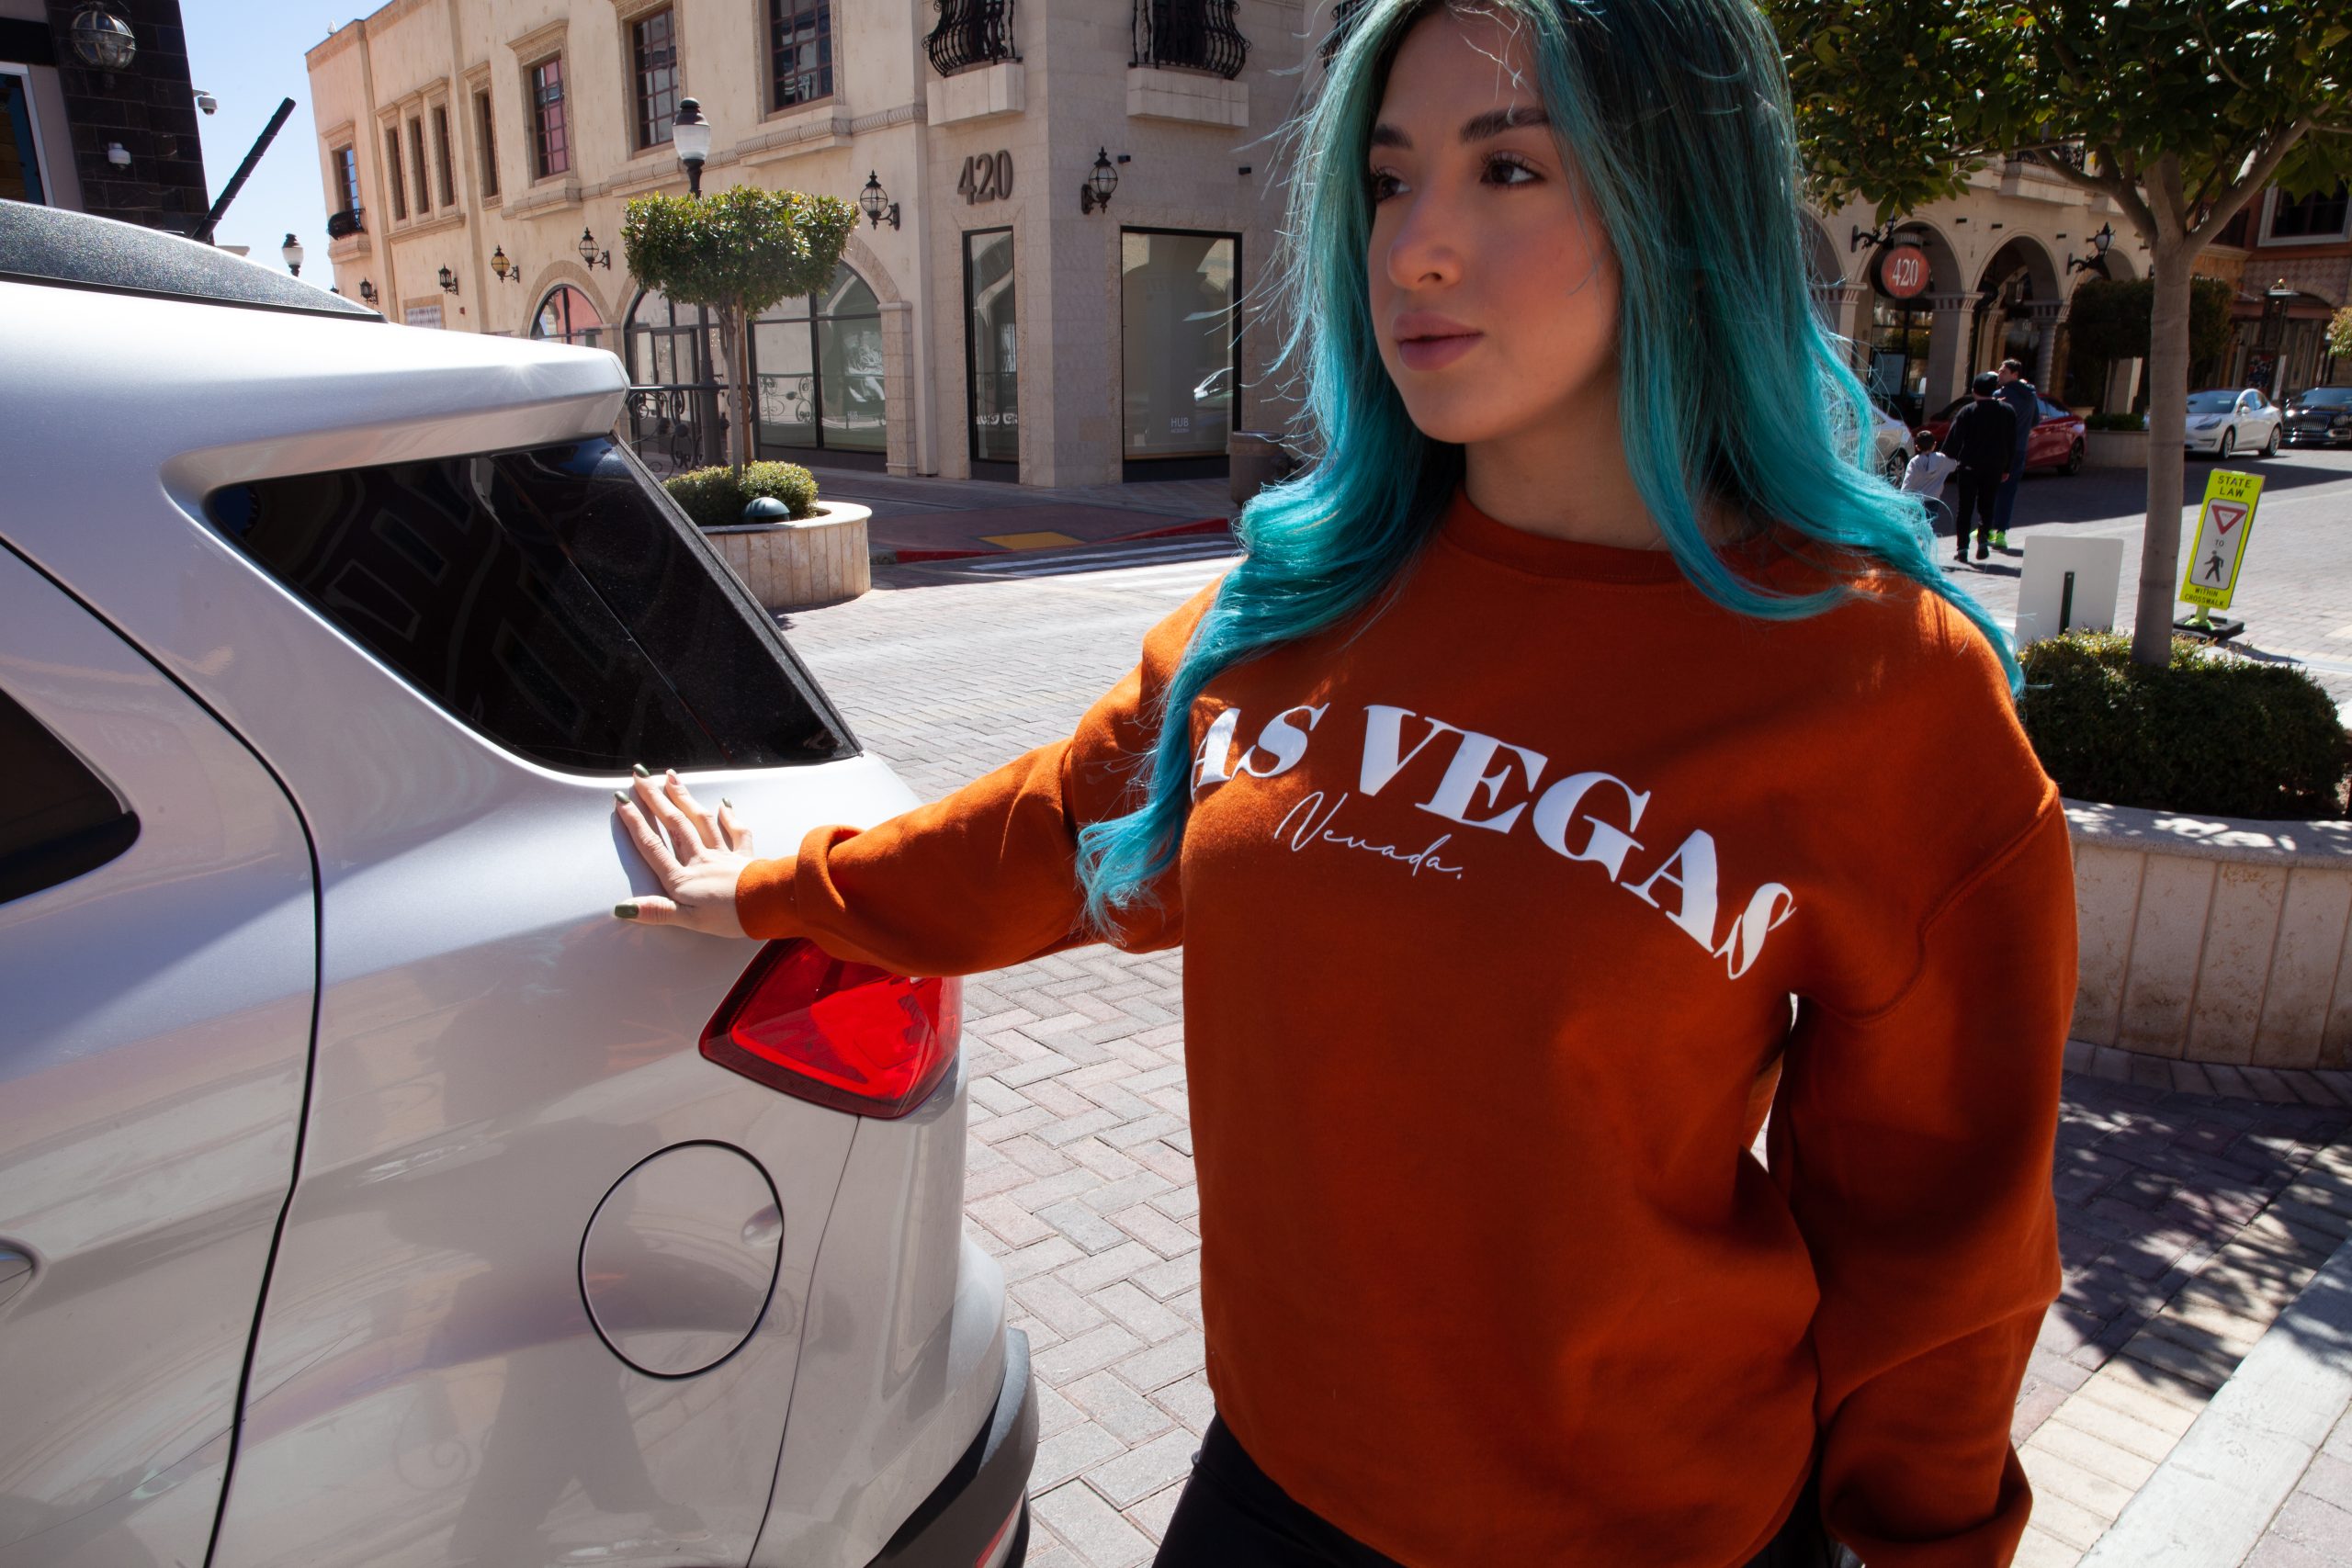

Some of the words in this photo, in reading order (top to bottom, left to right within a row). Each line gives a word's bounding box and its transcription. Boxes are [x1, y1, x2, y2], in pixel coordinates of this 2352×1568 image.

[956, 150, 1013, 205] 420
[1892, 258, 1919, 287] 420
[847, 411, 859, 420] HUB
[1170, 417, 1189, 427] HUB
[2217, 475, 2252, 489] STATE
[2220, 487, 2244, 498] LAW
[2215, 539, 2224, 547] TO
[2194, 587, 2219, 597] WITHIN
[2184, 593, 2224, 606] CROSSWALK
[1190, 702, 1331, 804] AS
[1359, 705, 1797, 980] VEGAS
